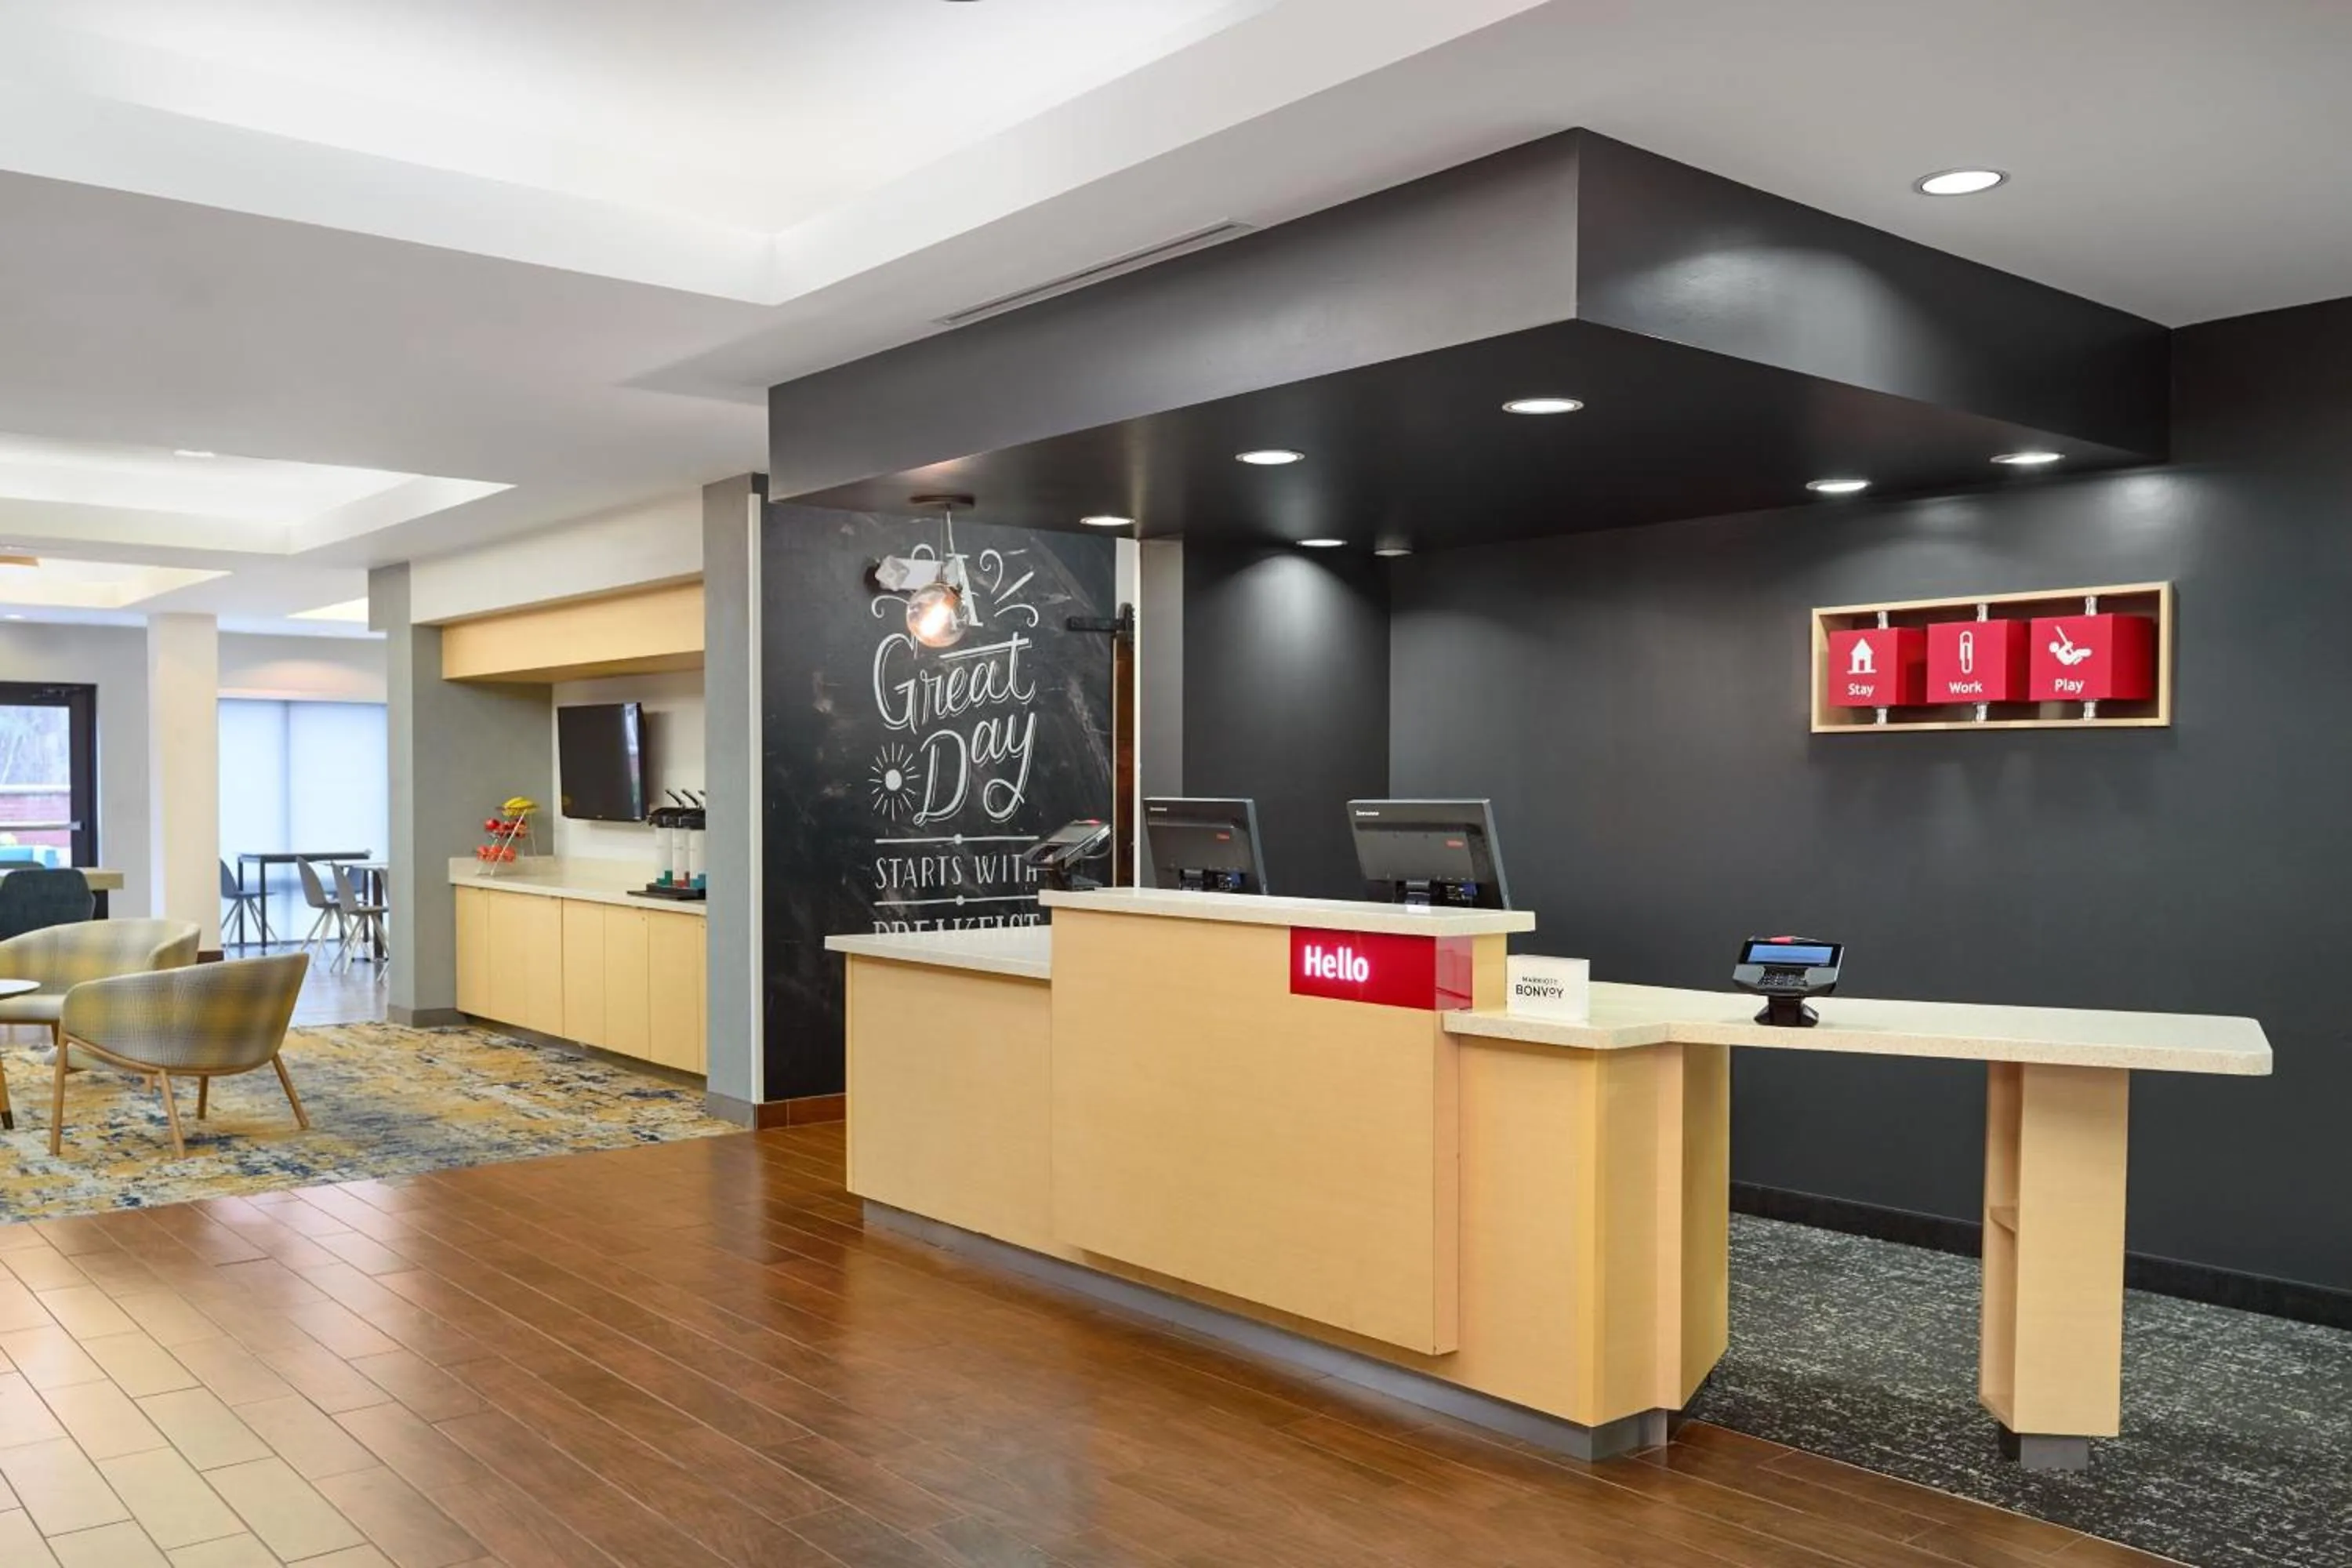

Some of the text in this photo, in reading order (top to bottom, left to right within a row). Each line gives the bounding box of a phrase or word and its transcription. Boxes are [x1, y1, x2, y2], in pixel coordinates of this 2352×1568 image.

[873, 632, 1036, 734] Great
[1847, 683, 1875, 697] Stay
[1948, 681, 1983, 694] Work
[2054, 678, 2085, 694] Play
[913, 712, 1036, 826] Day
[875, 856, 962, 889] STARTS
[1304, 945, 1369, 982] Hello
